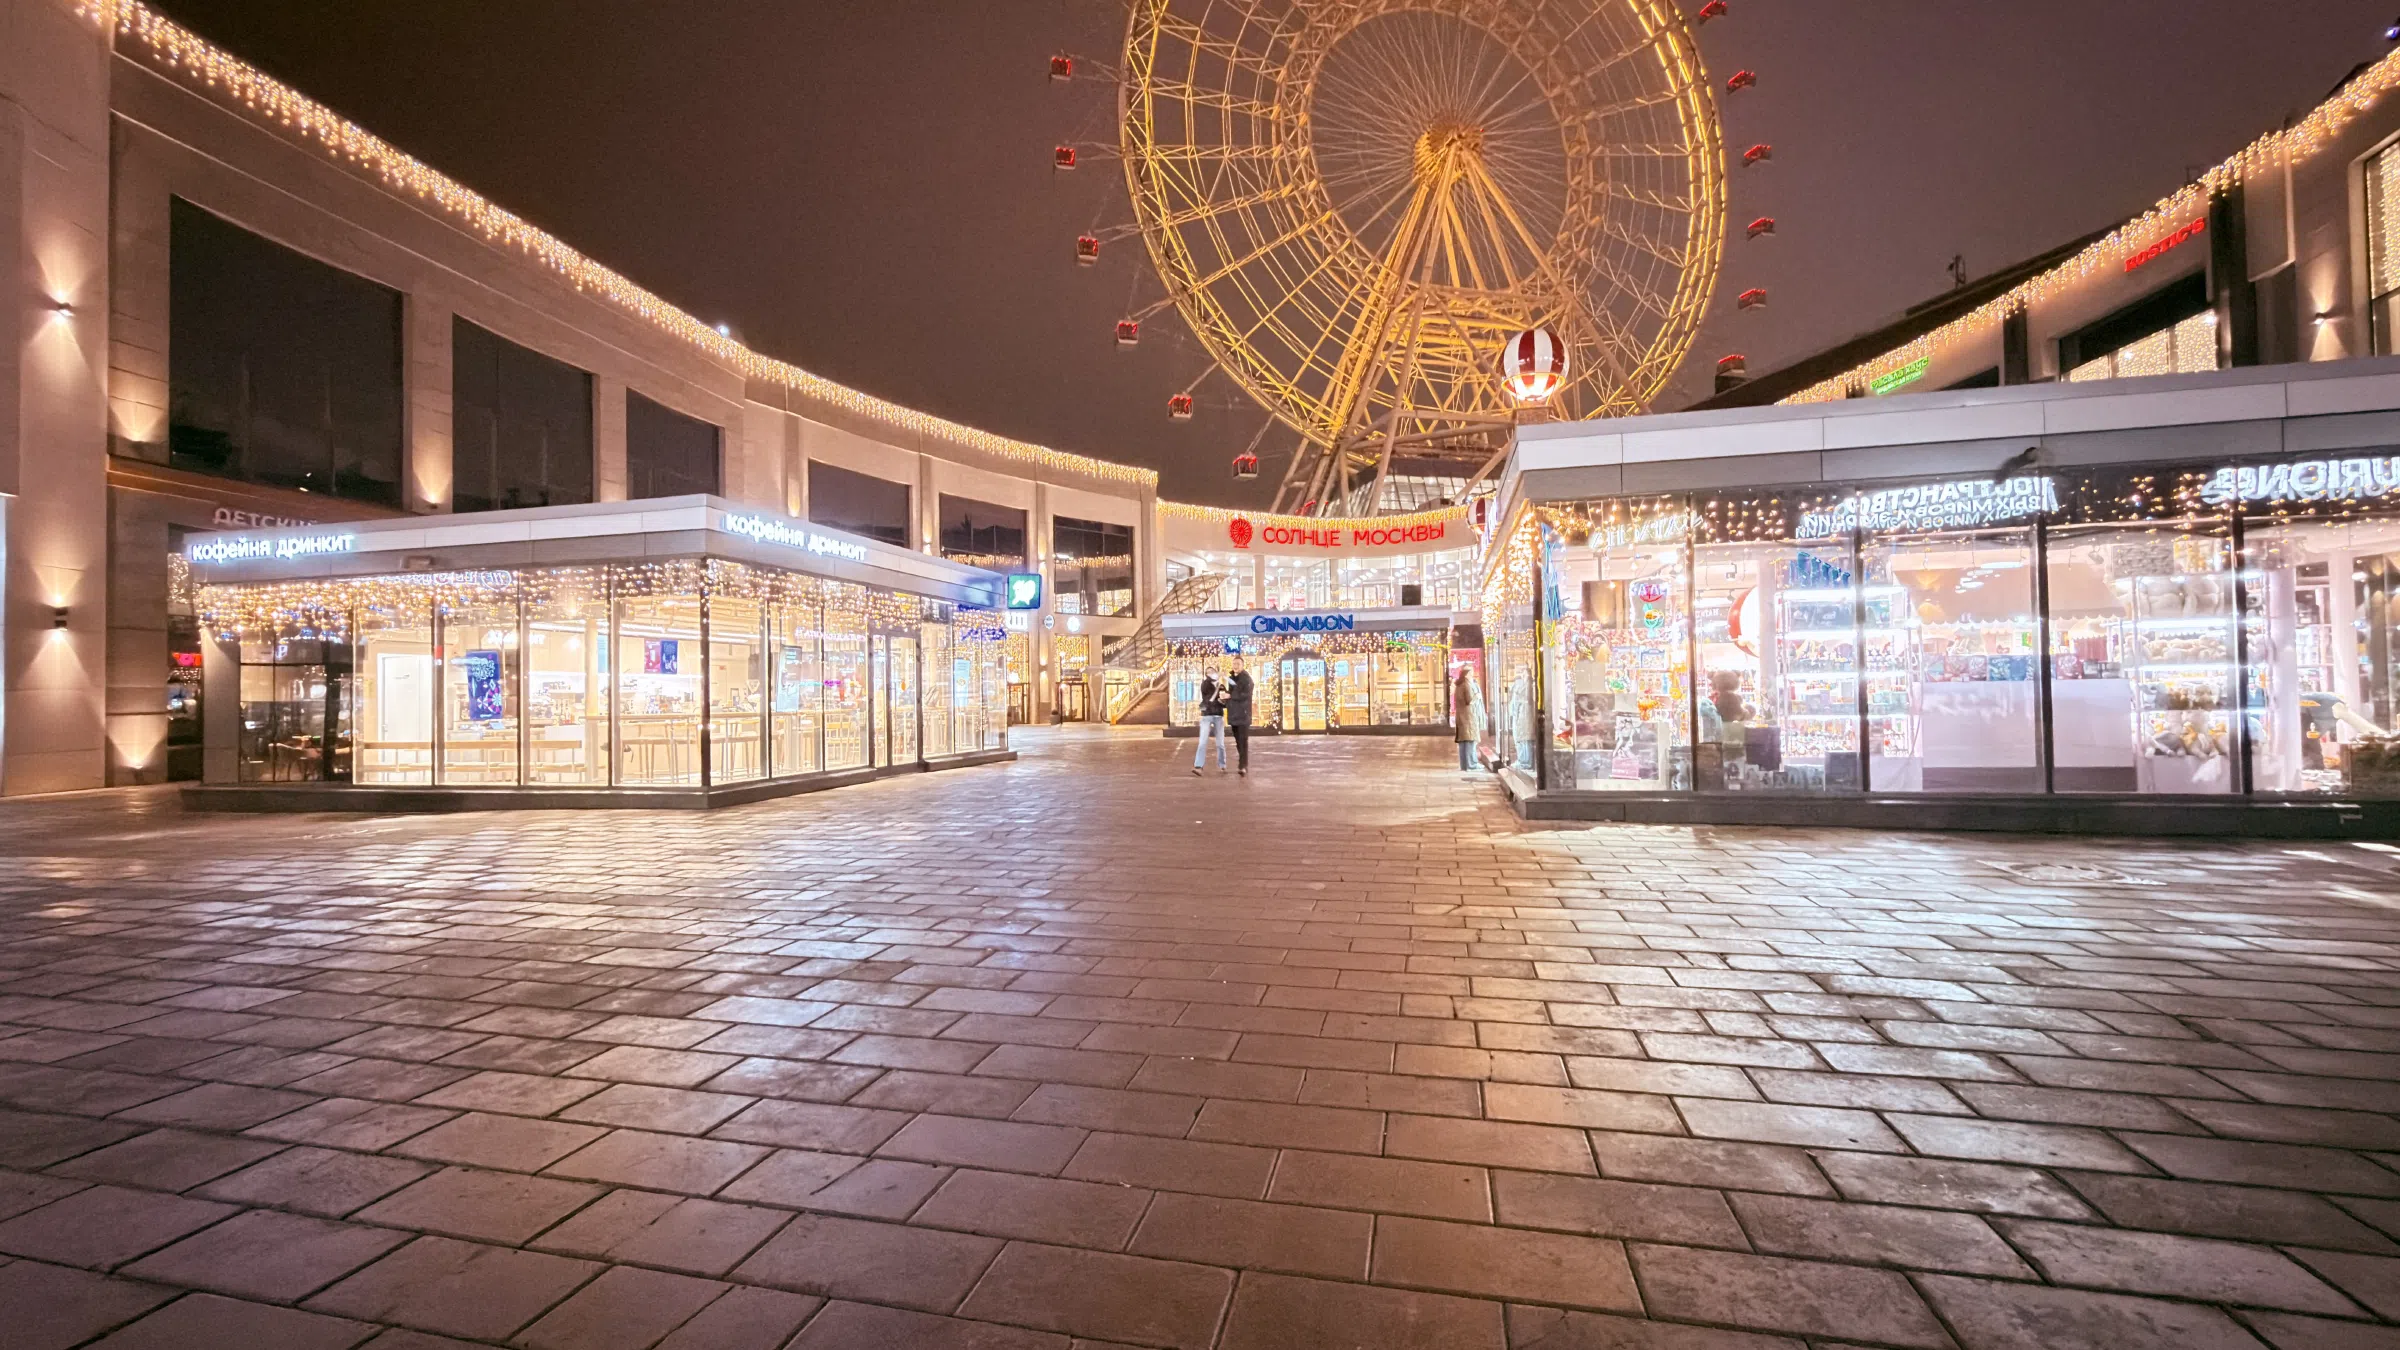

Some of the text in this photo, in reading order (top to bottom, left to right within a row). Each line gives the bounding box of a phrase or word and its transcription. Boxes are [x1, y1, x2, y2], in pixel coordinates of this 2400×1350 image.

[192, 533, 355, 565] кофейня дринкит
[807, 533, 868, 561] дринкит
[1262, 522, 1445, 549] СОЛНЦЕ МОСКВЫ
[1250, 613, 1354, 634] CINNABON
